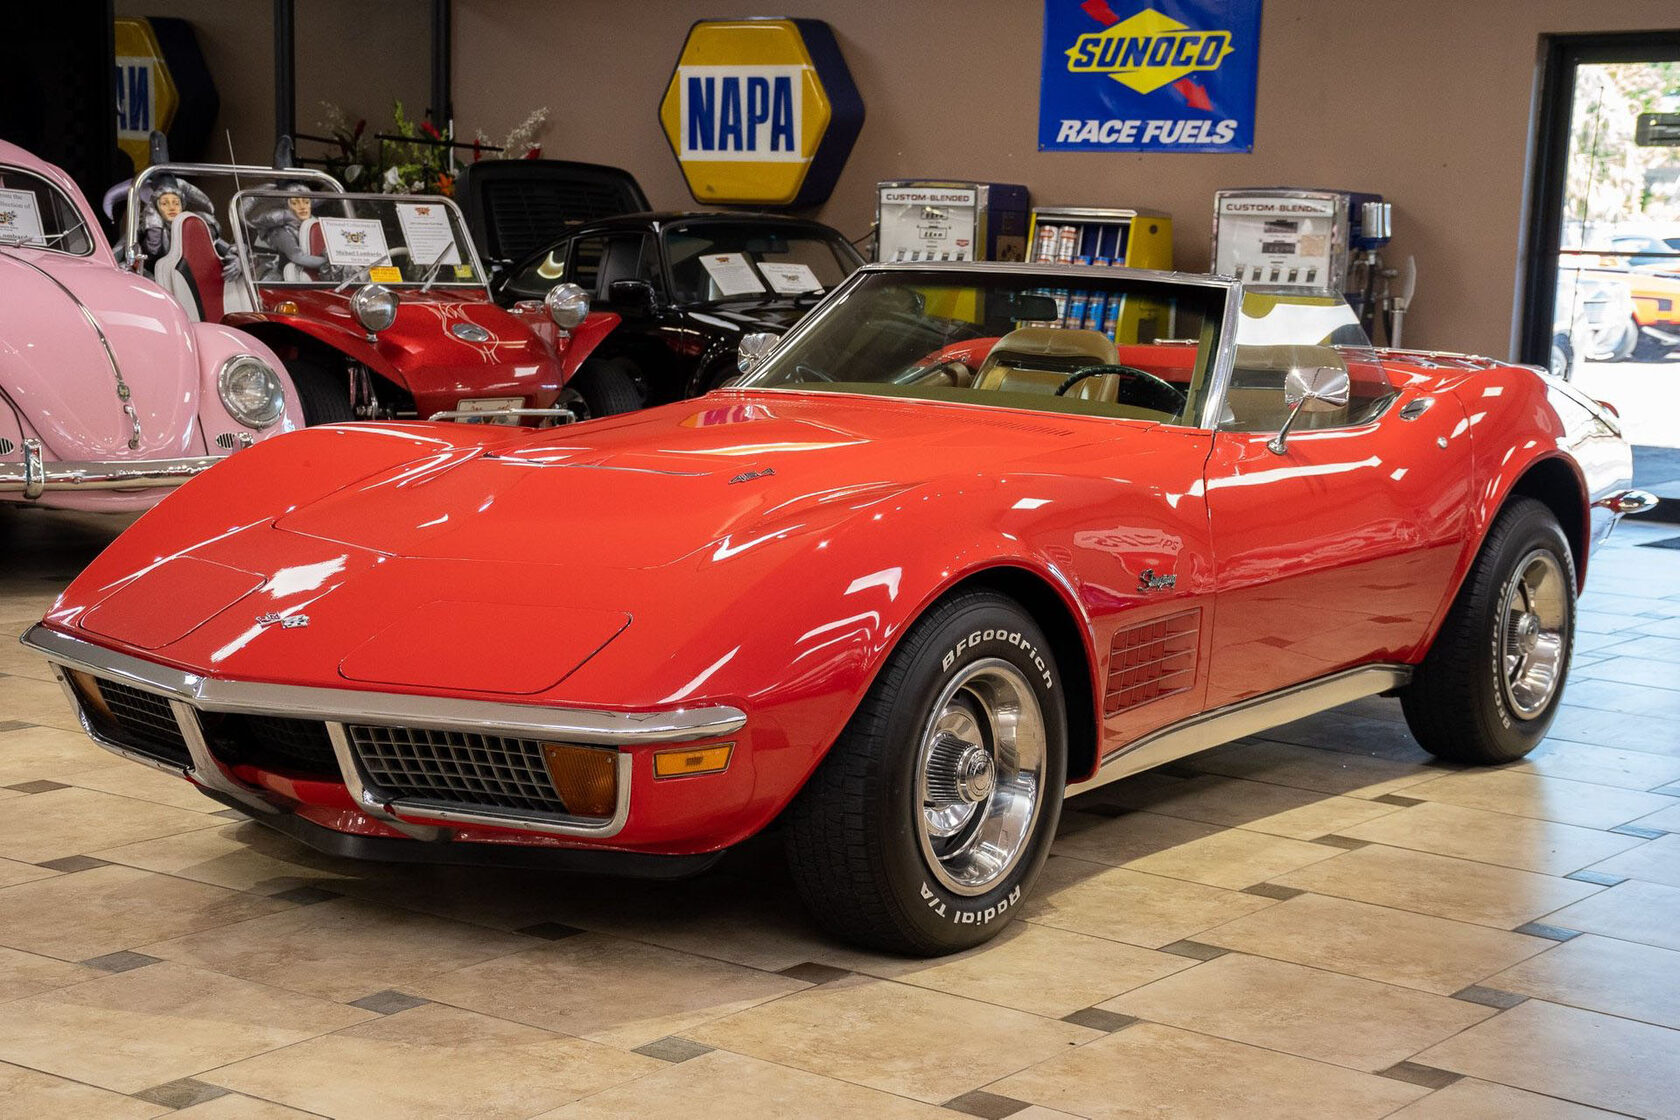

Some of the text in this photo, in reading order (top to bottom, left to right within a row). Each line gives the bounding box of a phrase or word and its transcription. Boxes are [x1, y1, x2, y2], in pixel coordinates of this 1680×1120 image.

[1073, 35, 1226, 68] SUNOCO
[688, 76, 795, 152] NAPA
[1056, 119, 1238, 144] RACE FUELS
[886, 193, 970, 202] CUSTOM-BLENDED
[942, 629, 1053, 689] BFGoodrich
[920, 881, 1021, 926] Radial T/A
